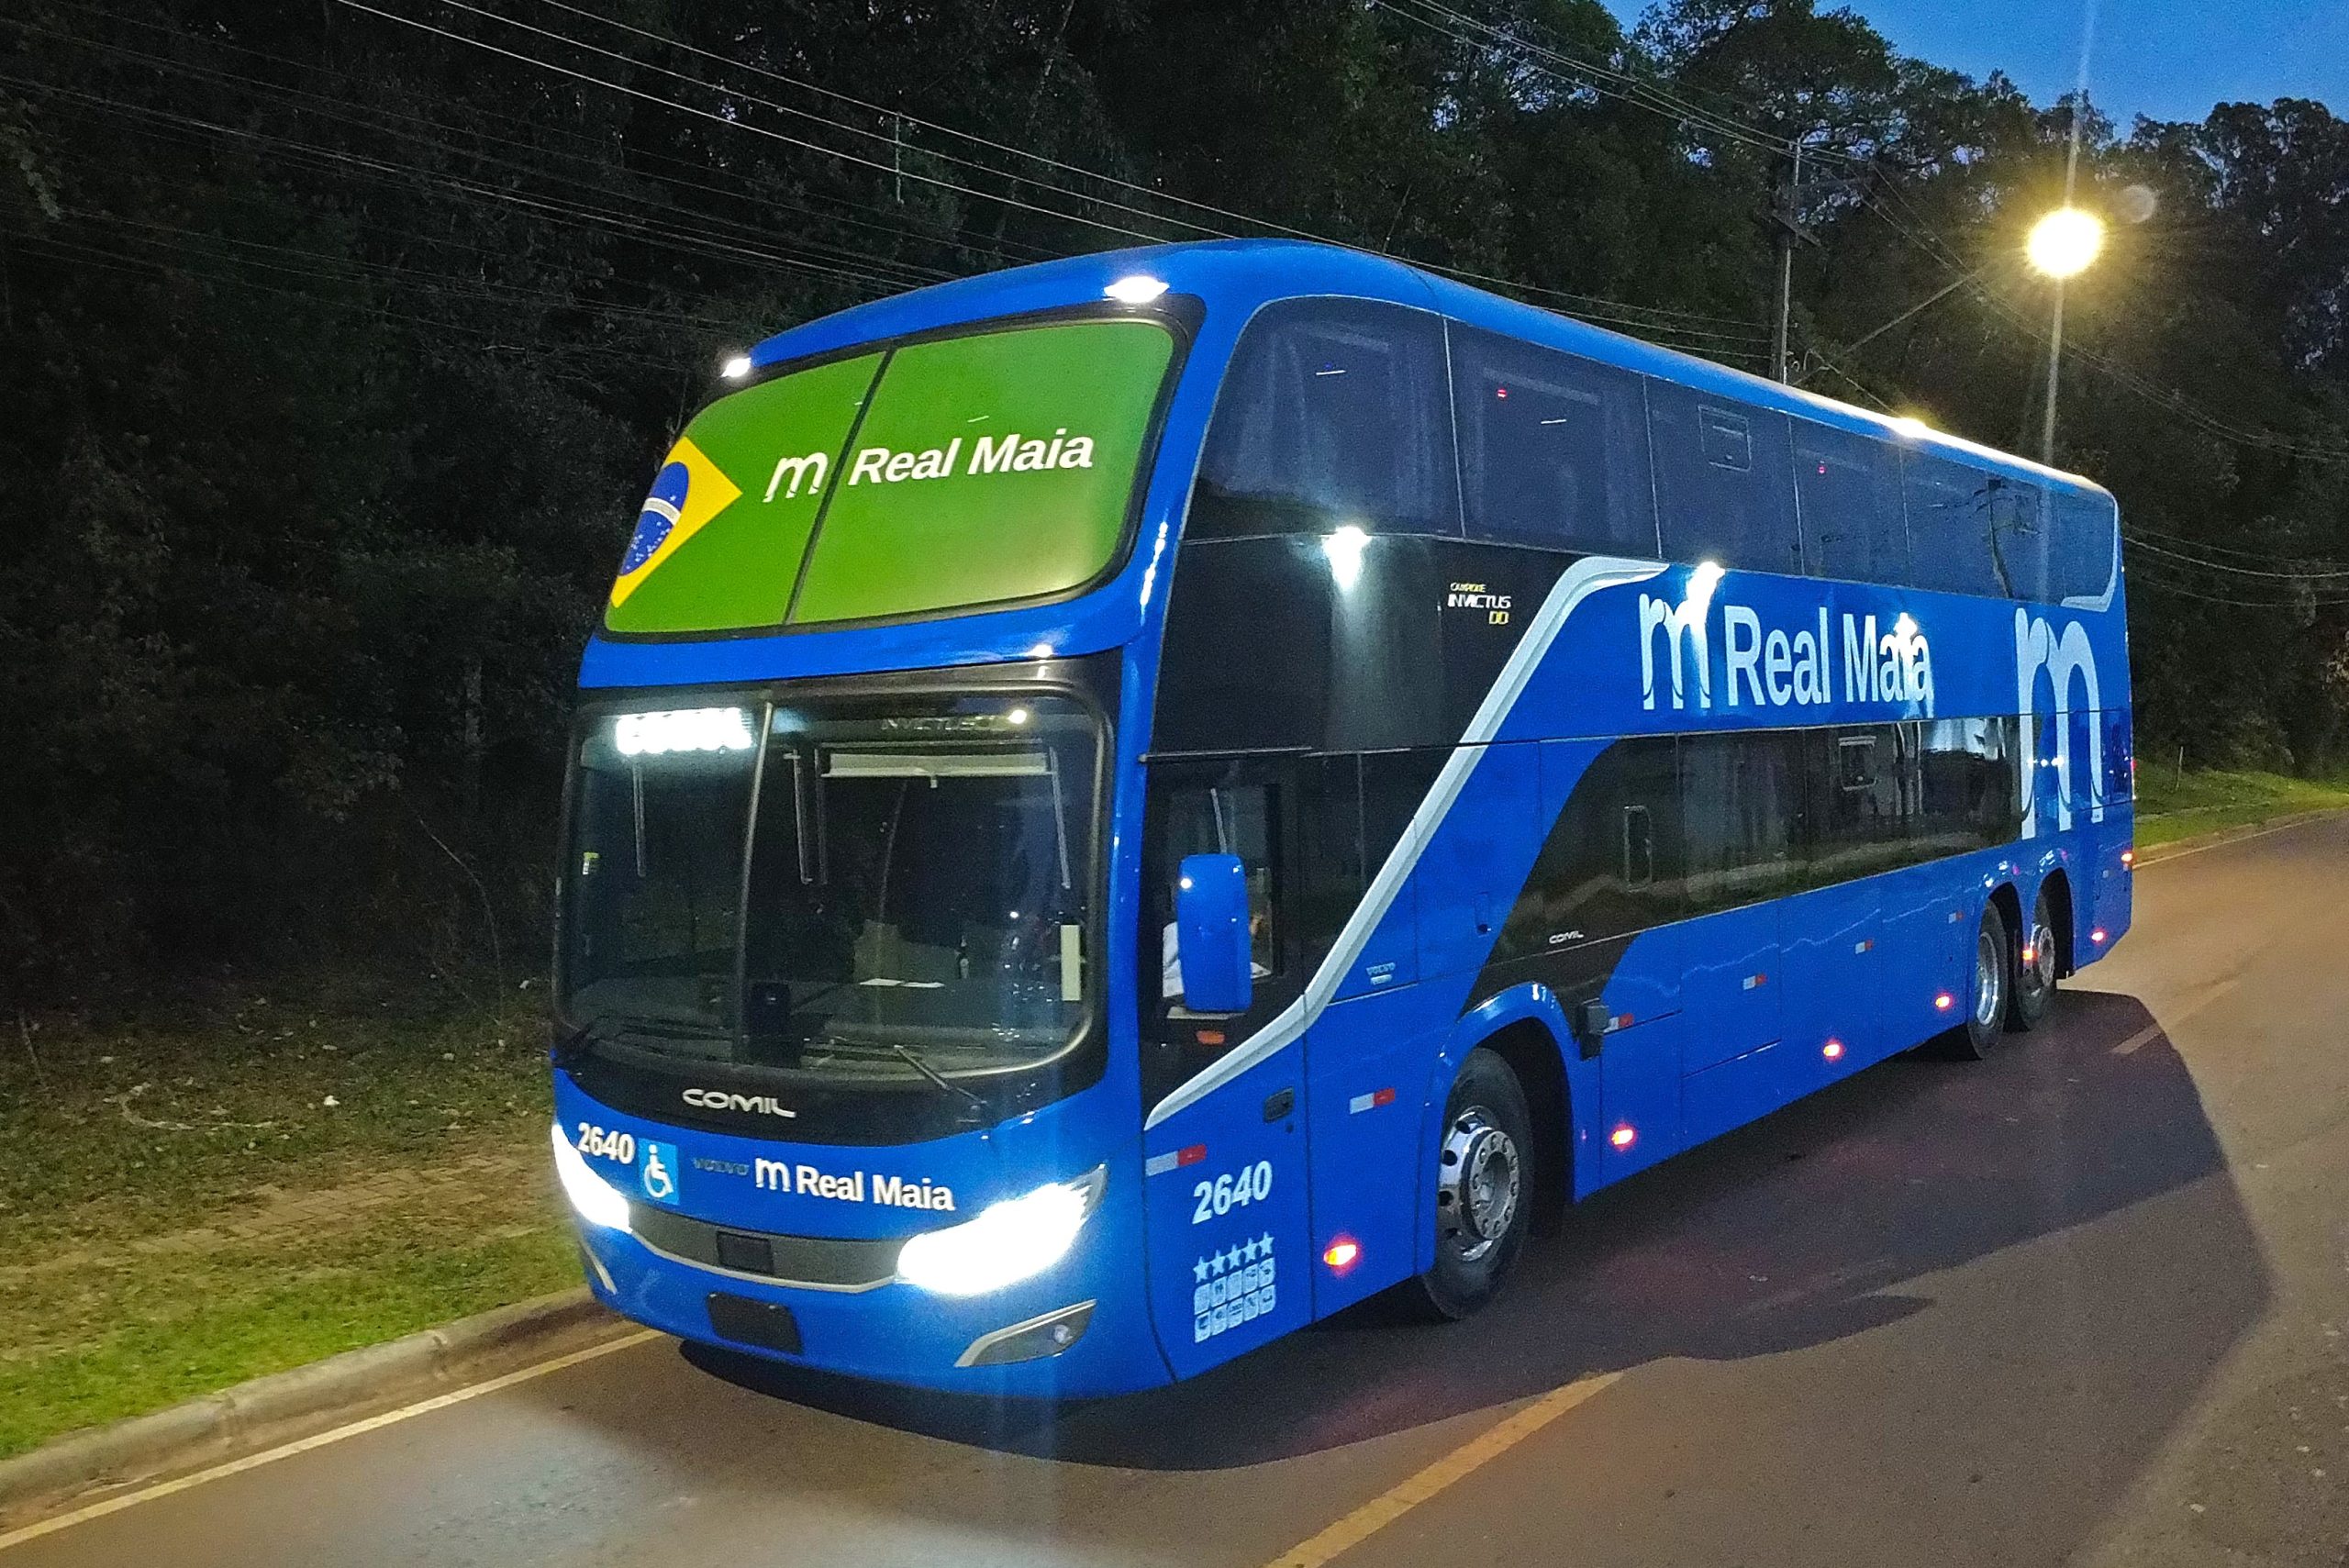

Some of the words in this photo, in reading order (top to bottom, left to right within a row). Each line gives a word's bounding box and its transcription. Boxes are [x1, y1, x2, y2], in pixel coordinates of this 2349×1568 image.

[848, 438, 963, 486] Real
[966, 428, 1095, 475] Maia
[1724, 604, 1831, 706] Real
[1549, 930, 1585, 944] COMIL
[682, 1088, 797, 1118] COMIL
[577, 1122, 636, 1164] 2640
[796, 1164, 865, 1203] Real
[872, 1173, 956, 1212] Maia
[1192, 1160, 1273, 1225] 2640
